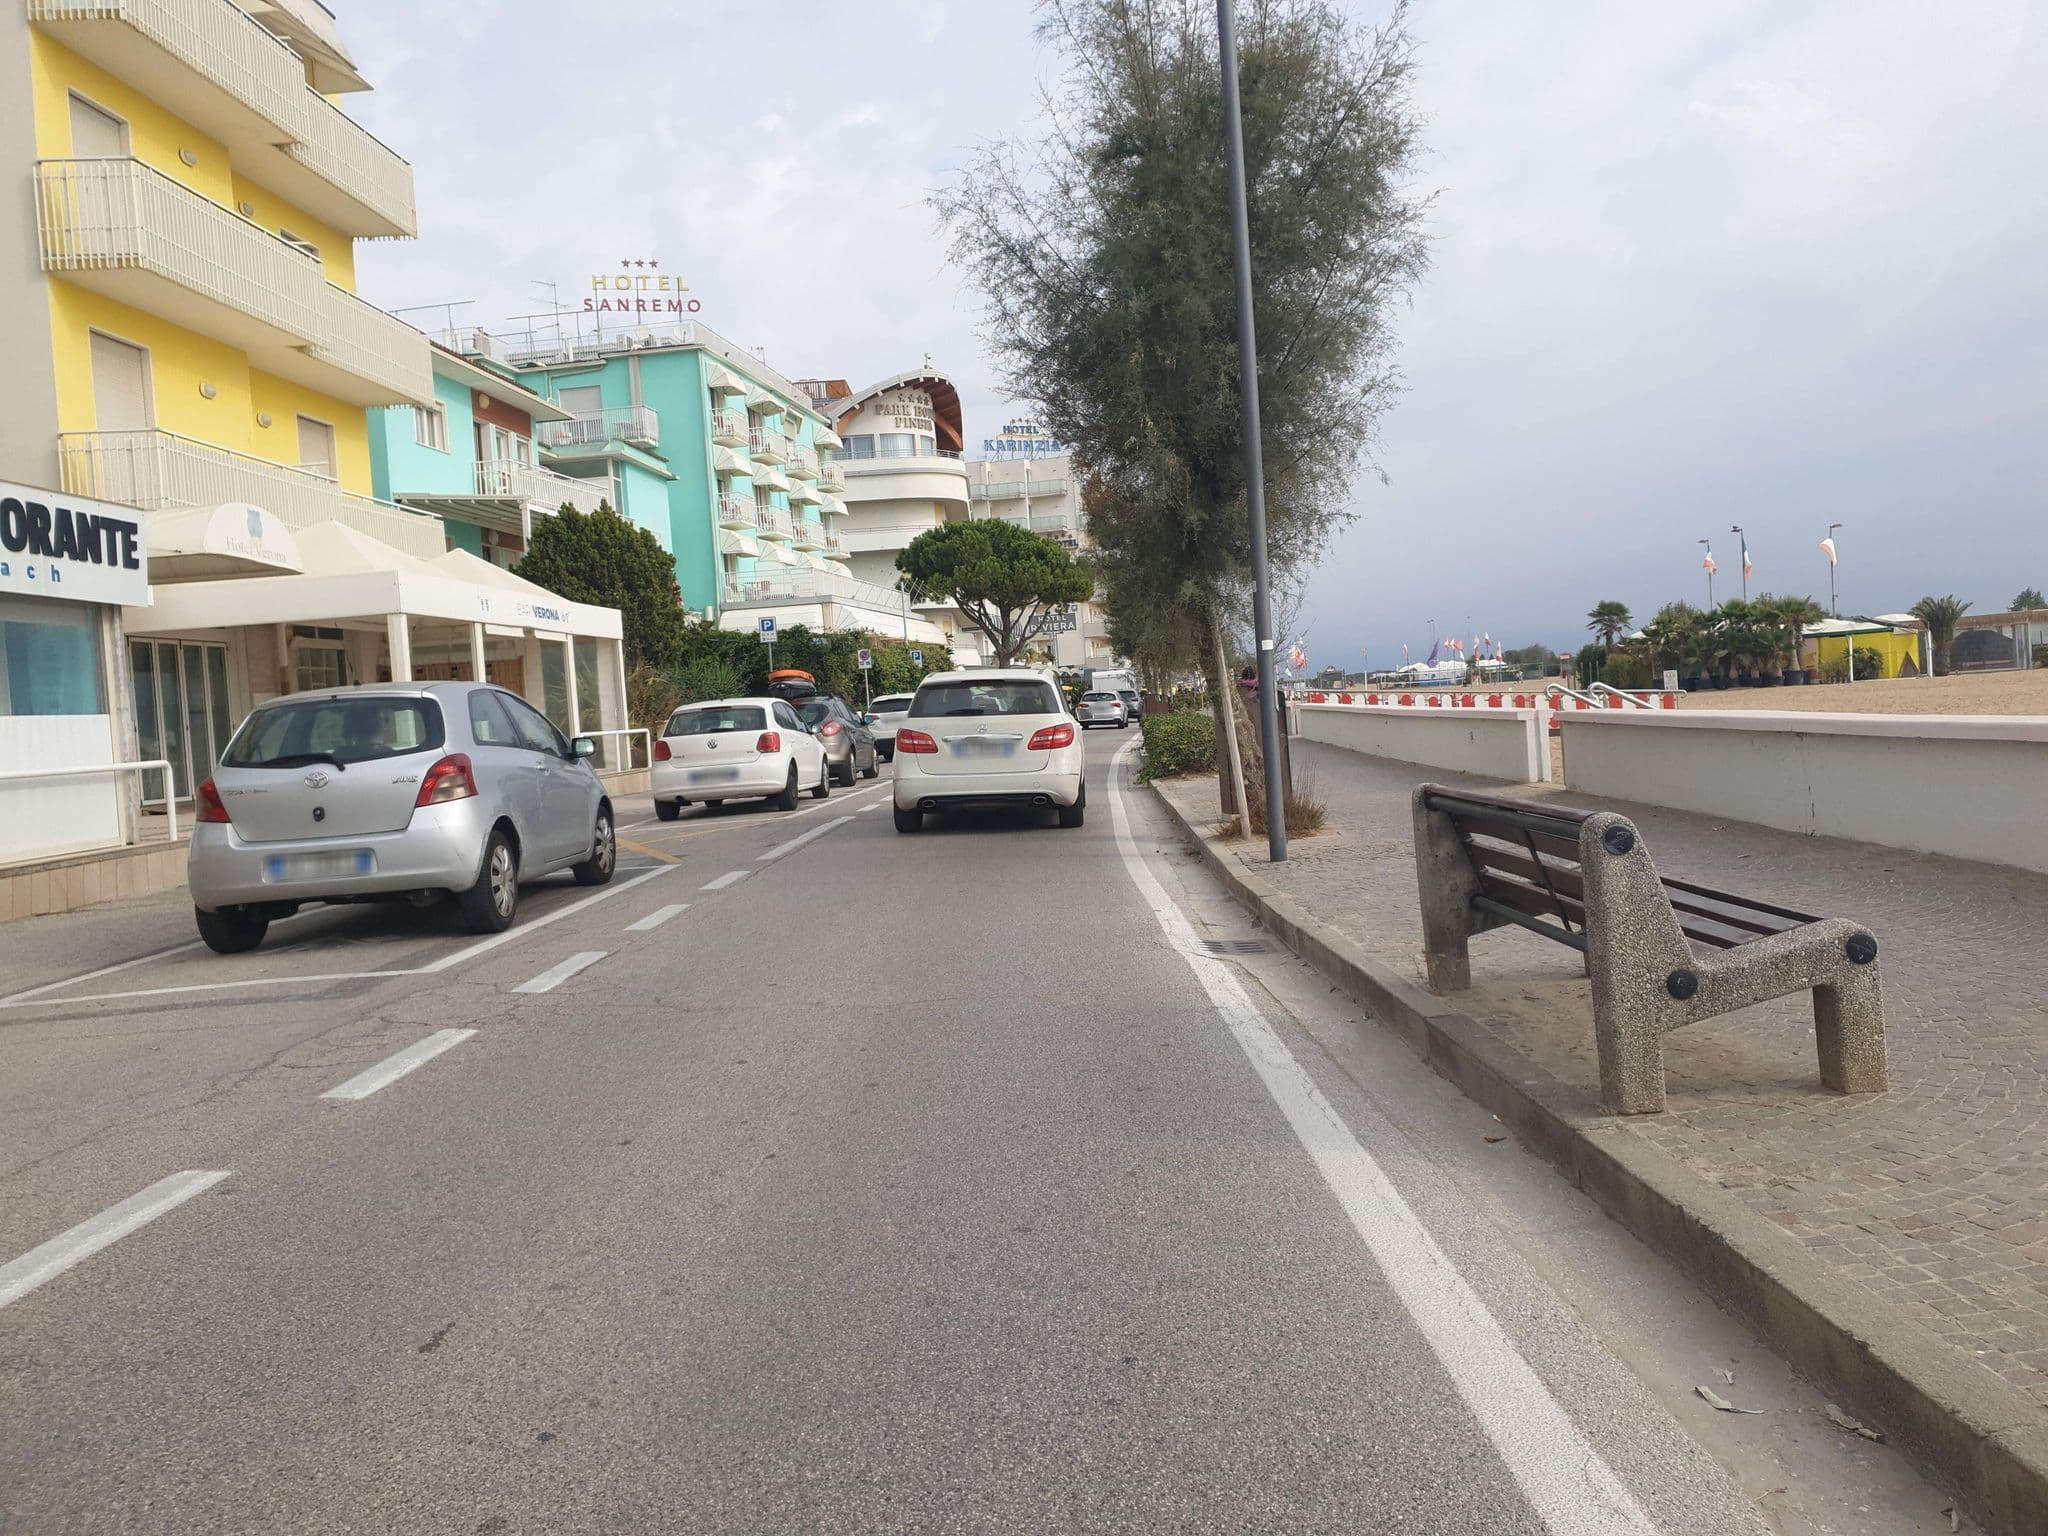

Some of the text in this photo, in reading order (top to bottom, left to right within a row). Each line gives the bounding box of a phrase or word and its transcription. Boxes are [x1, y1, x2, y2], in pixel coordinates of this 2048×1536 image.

[591, 274, 689, 291] HOTEL
[584, 298, 701, 312] SANREMO
[875, 404, 912, 416] PARK
[1003, 425, 1039, 434] HOTEL
[984, 440, 1060, 452] KARINZIA
[0, 497, 139, 570] ORANTE
[532, 605, 560, 621] VERONA
[764, 620, 772, 630] P
[1030, 621, 1075, 631] RVIERA
